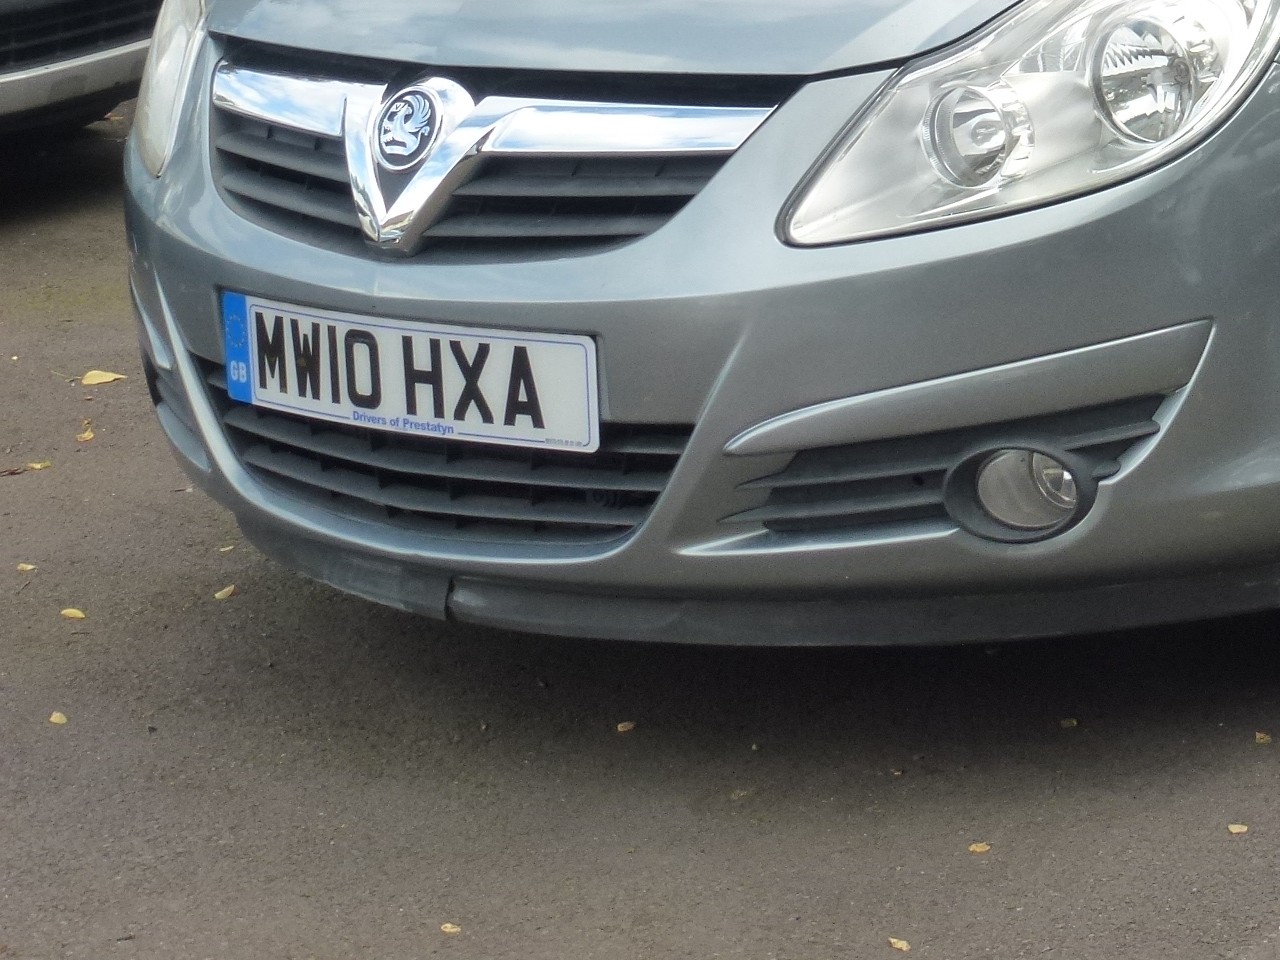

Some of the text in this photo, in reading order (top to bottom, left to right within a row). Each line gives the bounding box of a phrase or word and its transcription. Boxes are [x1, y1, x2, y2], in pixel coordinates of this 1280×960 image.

[230, 360, 247, 383] GB
[255, 311, 545, 429] MW10 HXA
[352, 410, 454, 435] Drivers of Prestatyn
